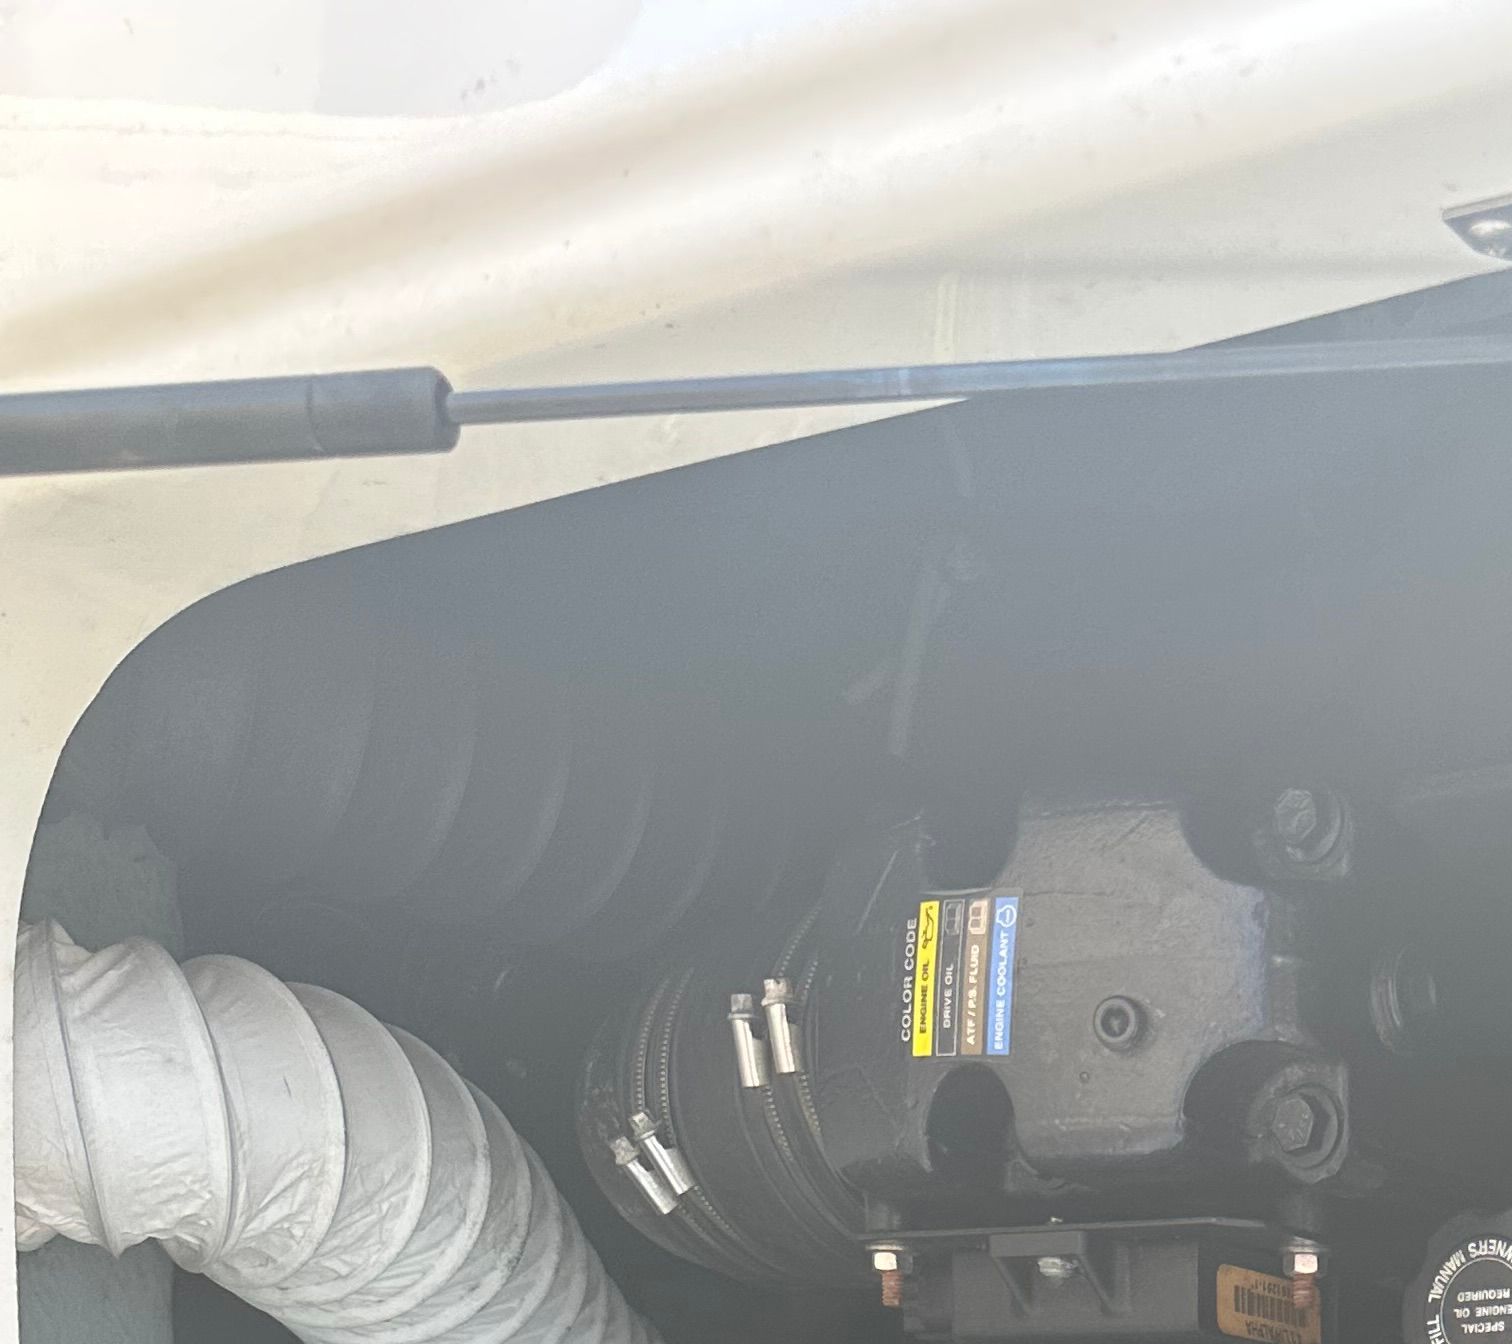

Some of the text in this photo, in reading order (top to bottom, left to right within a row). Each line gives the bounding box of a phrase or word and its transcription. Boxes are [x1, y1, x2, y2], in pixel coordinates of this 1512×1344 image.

[901, 918, 917, 1042] COLOR CODE
[969, 945, 979, 984] FLUID
[919, 960, 929, 1034] ENGINE OIL
[942, 963, 953, 1029] DRIVE OIL
[993, 930, 1009, 1050] ENGINE COOLANT
[966, 1018, 976, 1046] ATF
[1427, 1249, 1466, 1303] MANUAL
[1457, 1288, 1511, 1303] REQUIRED
[1453, 1307, 1471, 1319] OIL
[1460, 1321, 1505, 1335] SPECIAL
